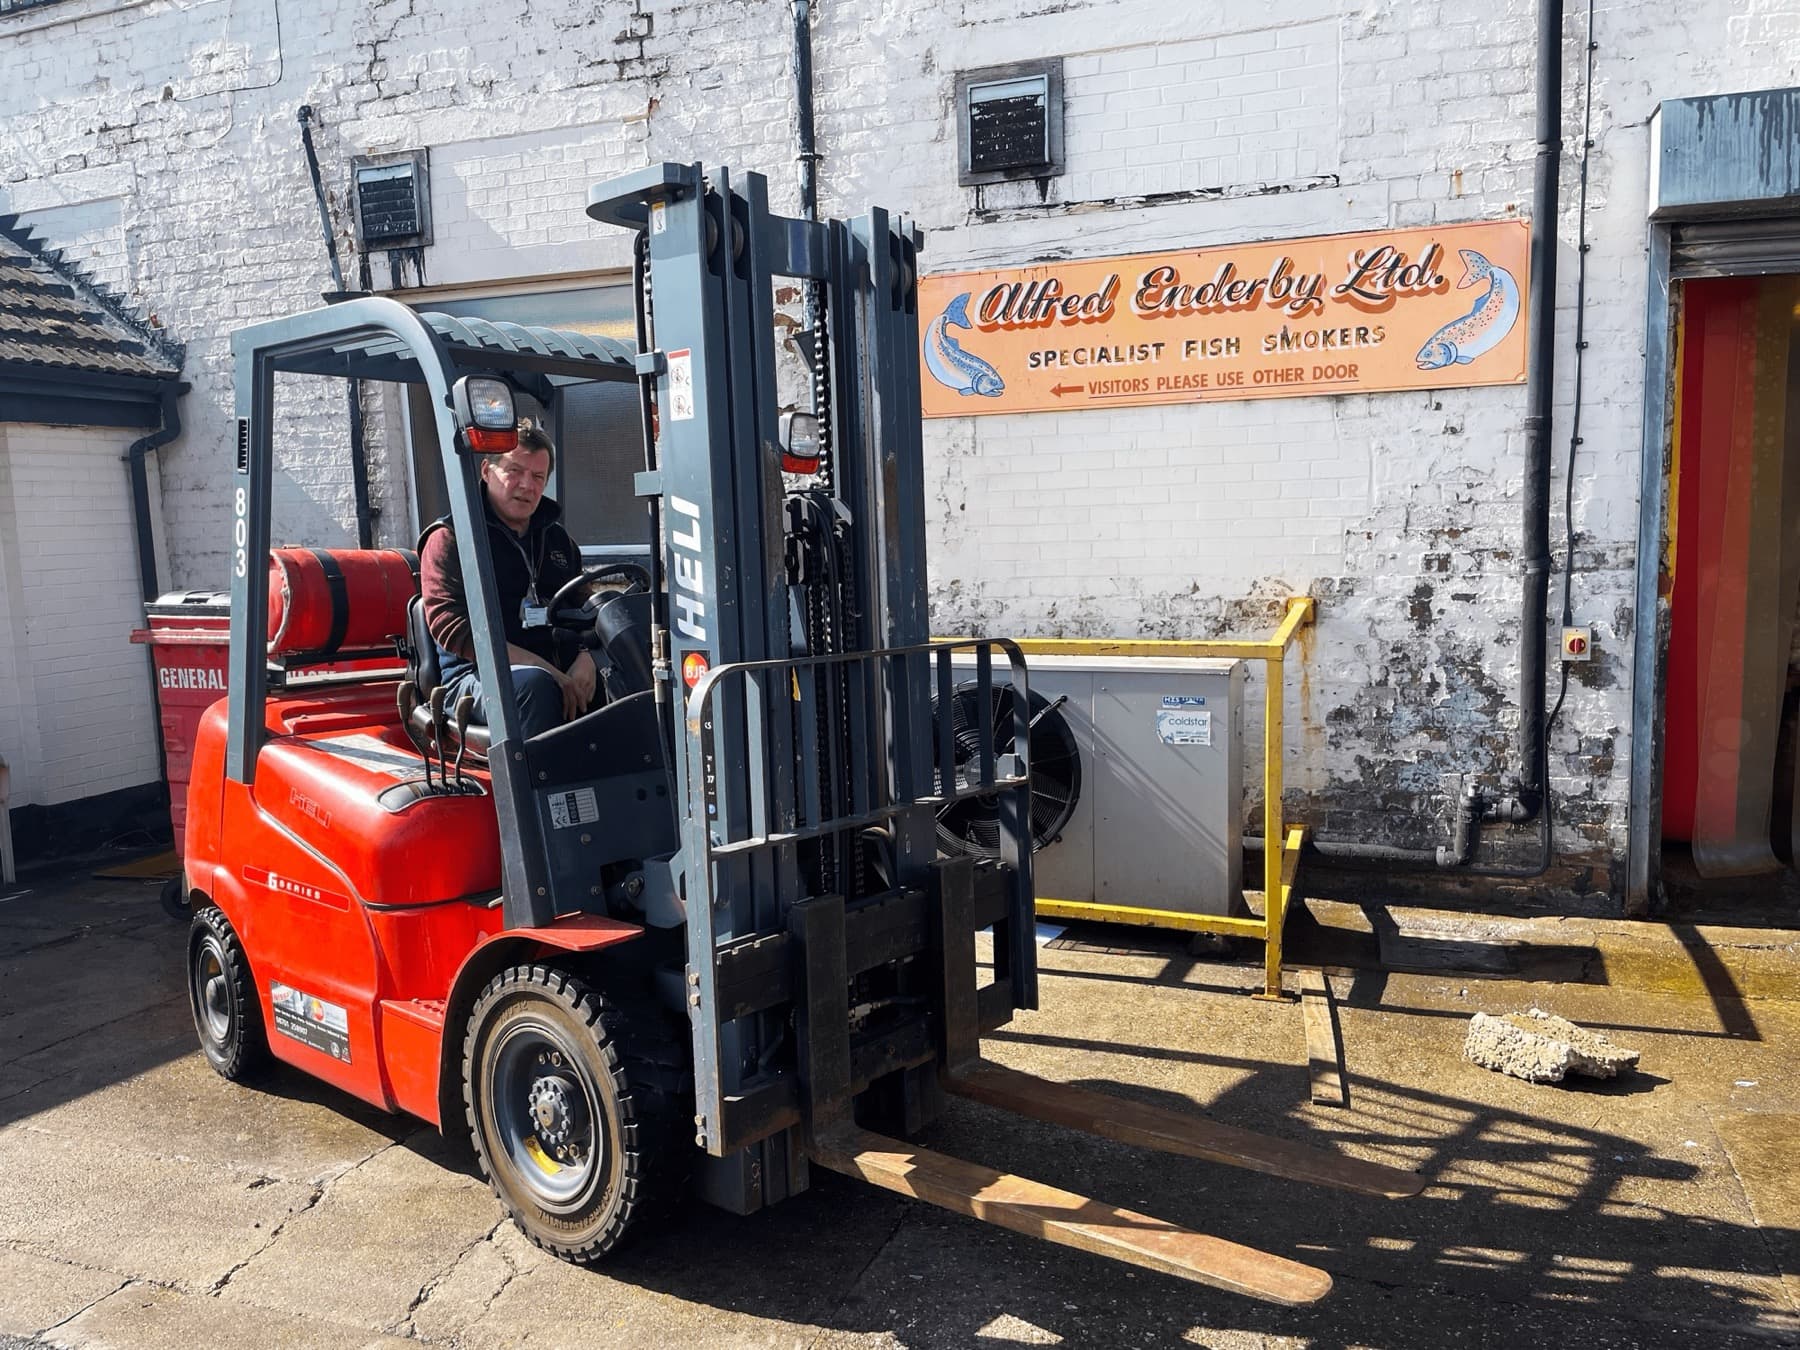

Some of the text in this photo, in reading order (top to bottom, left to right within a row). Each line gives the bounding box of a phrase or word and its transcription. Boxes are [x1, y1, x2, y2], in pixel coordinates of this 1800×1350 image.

[976, 243, 1448, 329] Alfred Enderby Ltd.
[1028, 325, 1386, 369] SPECIALIST FISH SMOKERS
[1088, 364, 1359, 395] VISITORS PLEASE USE OTHER DOOR
[235, 487, 247, 578] 803
[671, 495, 706, 642] HELI
[159, 667, 227, 690] GENERAL
[1168, 716, 1208, 728] coldstar
